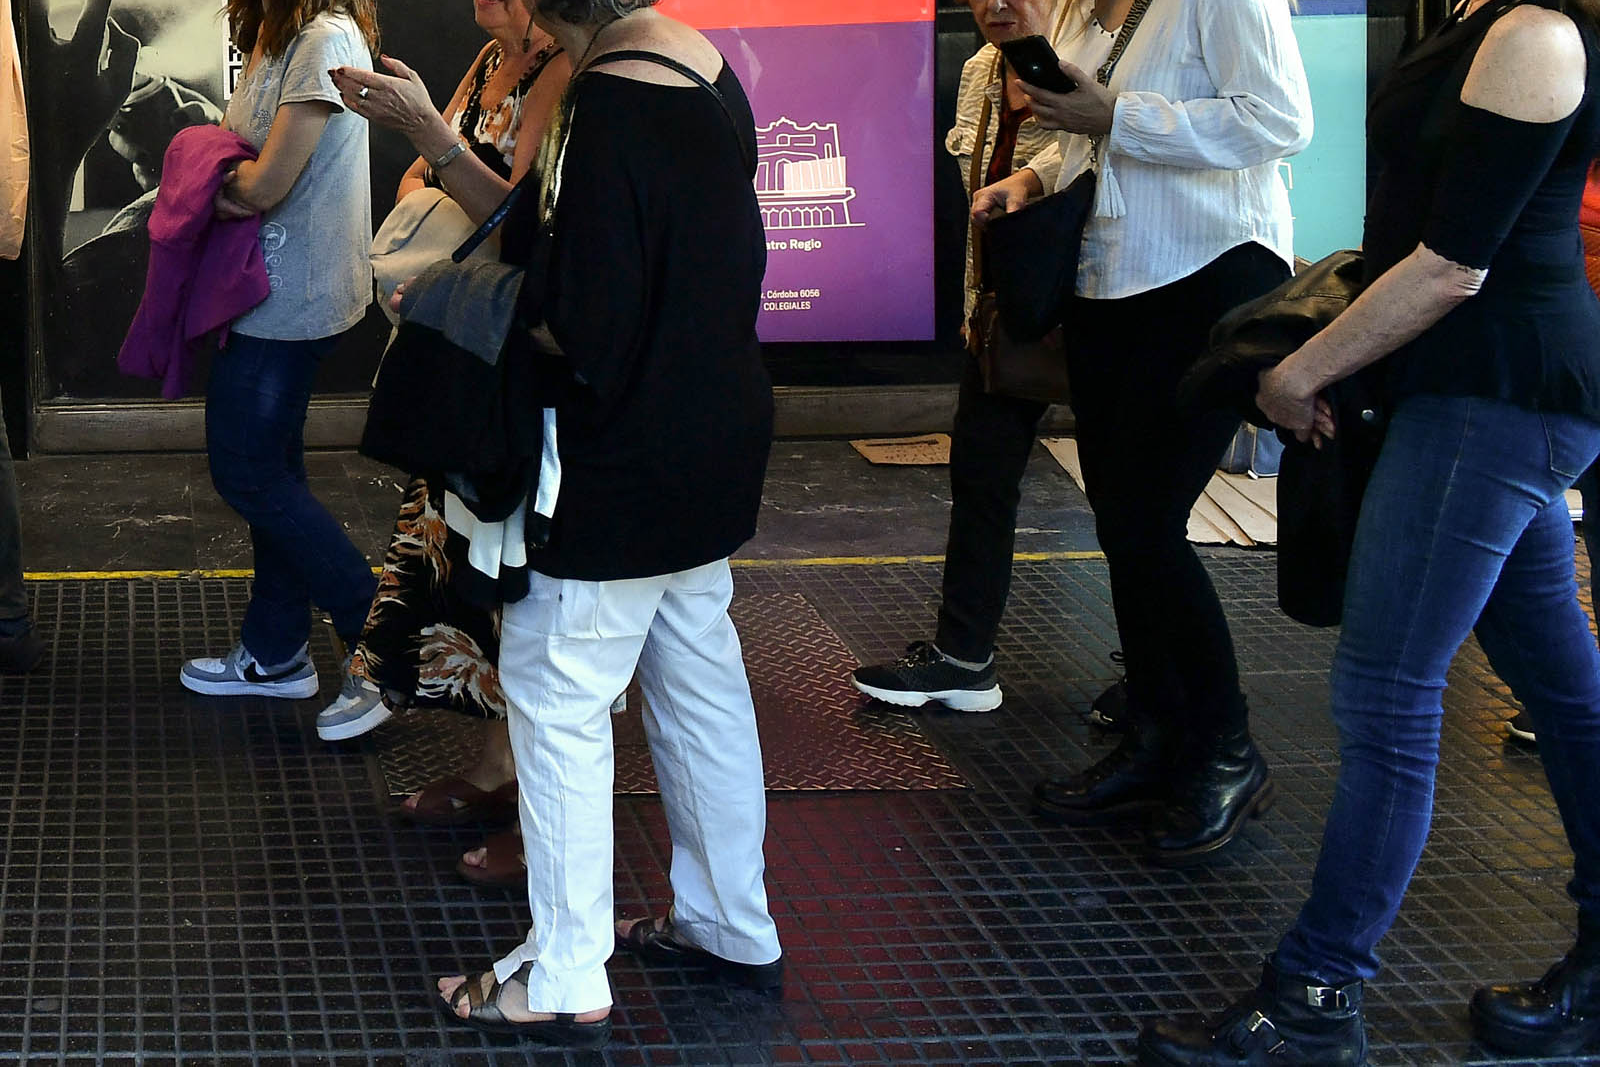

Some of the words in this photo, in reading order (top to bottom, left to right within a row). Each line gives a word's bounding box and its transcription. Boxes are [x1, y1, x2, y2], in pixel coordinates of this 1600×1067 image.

[789, 239, 822, 251] Regio
[767, 289, 799, 299] Córdoba
[800, 289, 820, 298] 6056
[763, 301, 811, 311] COLEGIALES
